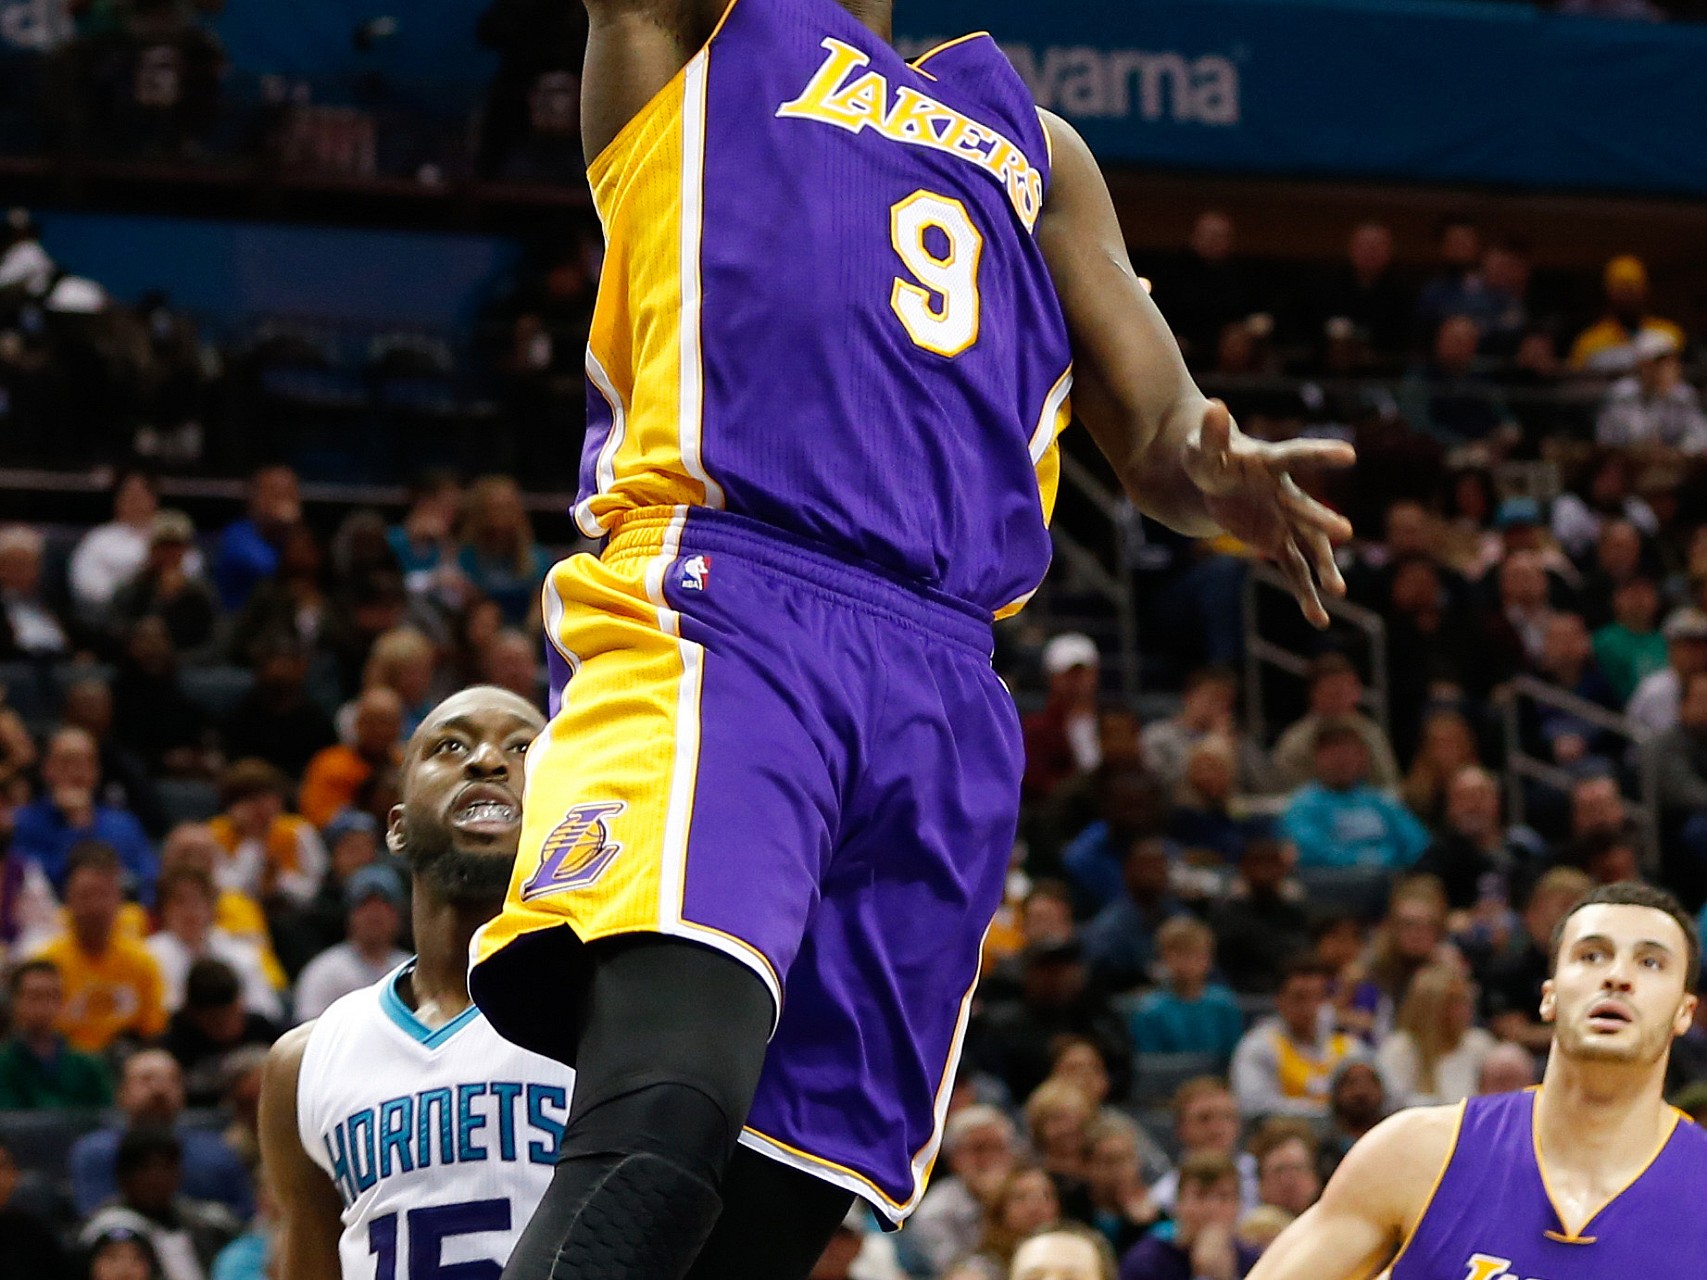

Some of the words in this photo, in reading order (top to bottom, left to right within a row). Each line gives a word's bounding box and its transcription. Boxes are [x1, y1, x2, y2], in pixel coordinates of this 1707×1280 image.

[775, 38, 1042, 234] LAKERS
[890, 189, 982, 358] 9
[324, 1081, 567, 1208] HORNETS
